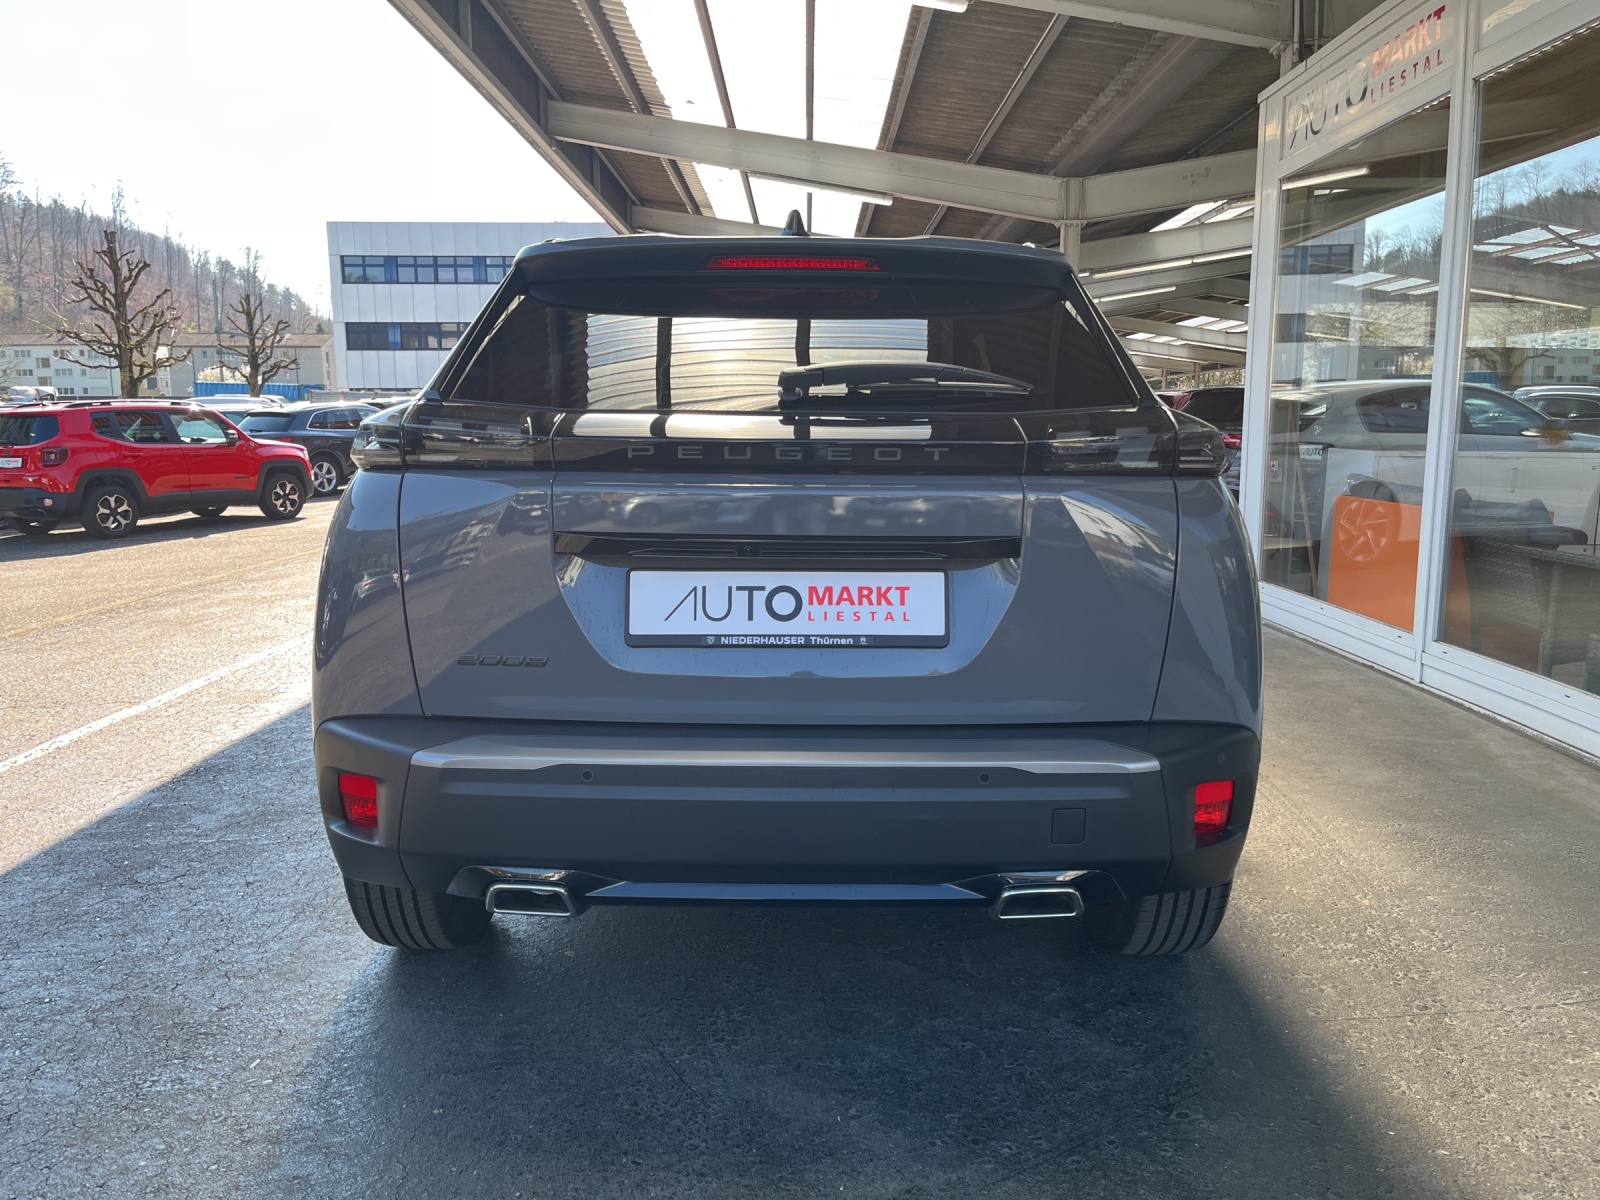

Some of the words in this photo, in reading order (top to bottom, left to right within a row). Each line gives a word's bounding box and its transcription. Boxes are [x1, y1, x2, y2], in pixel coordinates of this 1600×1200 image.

[1289, 59, 1369, 149] AUTO
[1372, 5, 1446, 80] MARKT
[1370, 49, 1443, 104] LIESTAL
[627, 446, 949, 461] PEUGEOT
[664, 585, 803, 622] AUTO
[807, 586, 910, 606] MARKT
[807, 611, 910, 622] LIESTAL
[720, 636, 805, 645] NIEDERHAUSER
[810, 636, 853, 645] Thürnen
[457, 654, 549, 667] 2008
